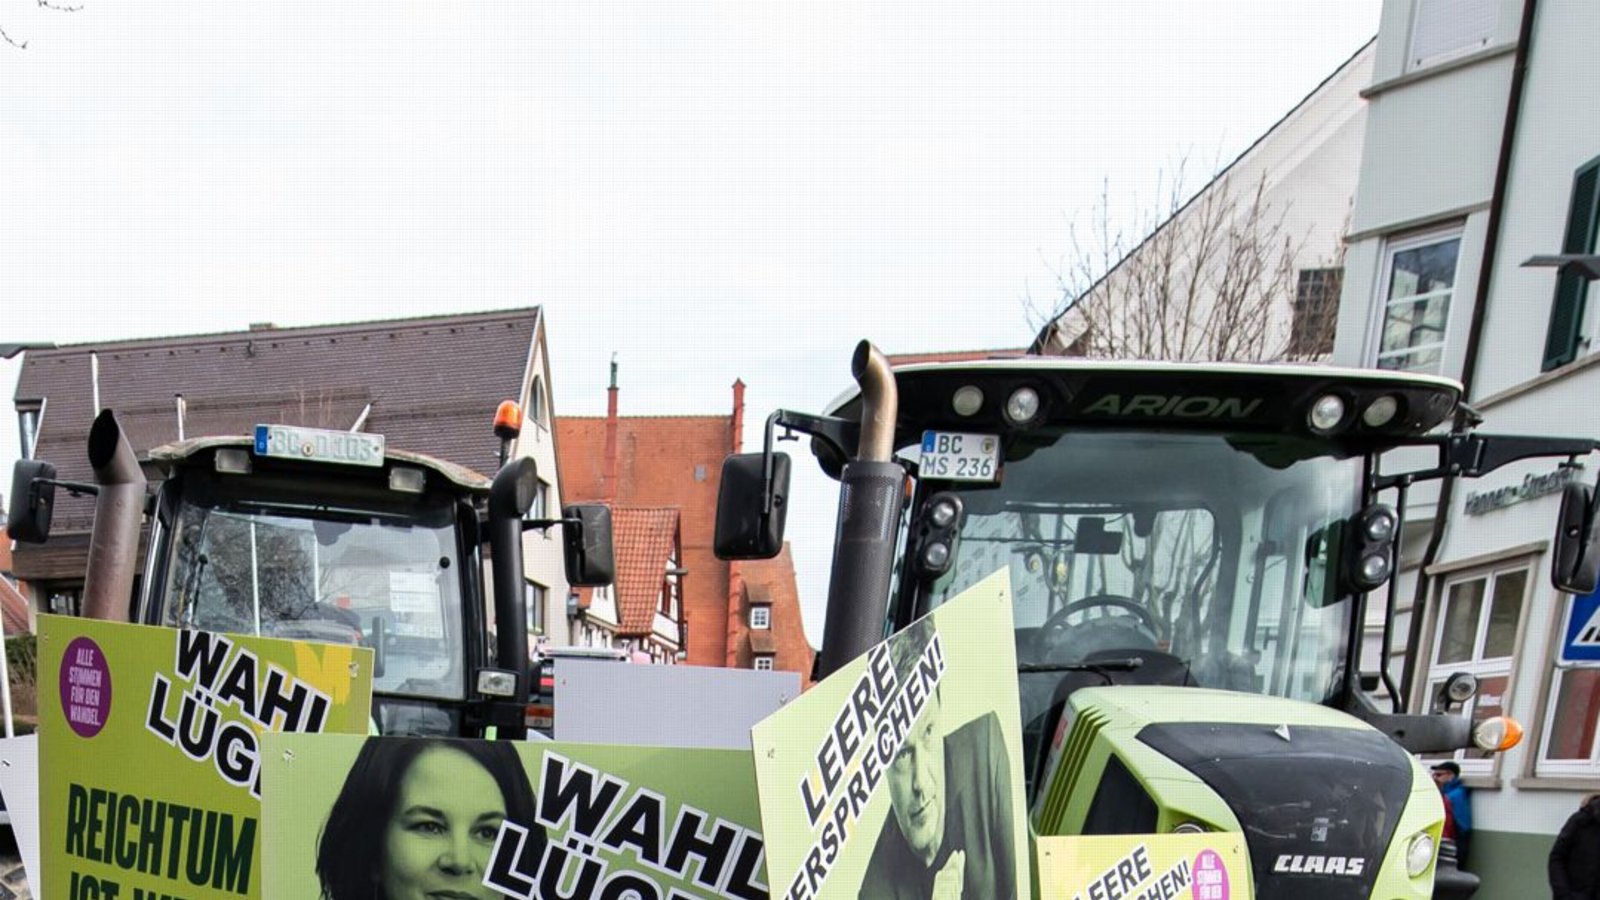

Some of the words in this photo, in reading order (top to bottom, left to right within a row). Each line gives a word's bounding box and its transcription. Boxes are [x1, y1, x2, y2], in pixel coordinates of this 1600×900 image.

[1081, 394, 1264, 418] ARION
[272, 429, 299, 455] BC
[921, 456, 949, 475] MS
[956, 456, 991, 477] 236
[938, 435, 963, 454] BC
[147, 678, 261, 796] LÜG
[800, 641, 898, 827] LEERE
[784, 634, 945, 900] ERSPRECHEN!
[66, 783, 257, 895] REICHTUM
[540, 757, 771, 900] WAHL
[1074, 846, 1152, 900] EERE
[1274, 855, 1365, 875] CLAAS
